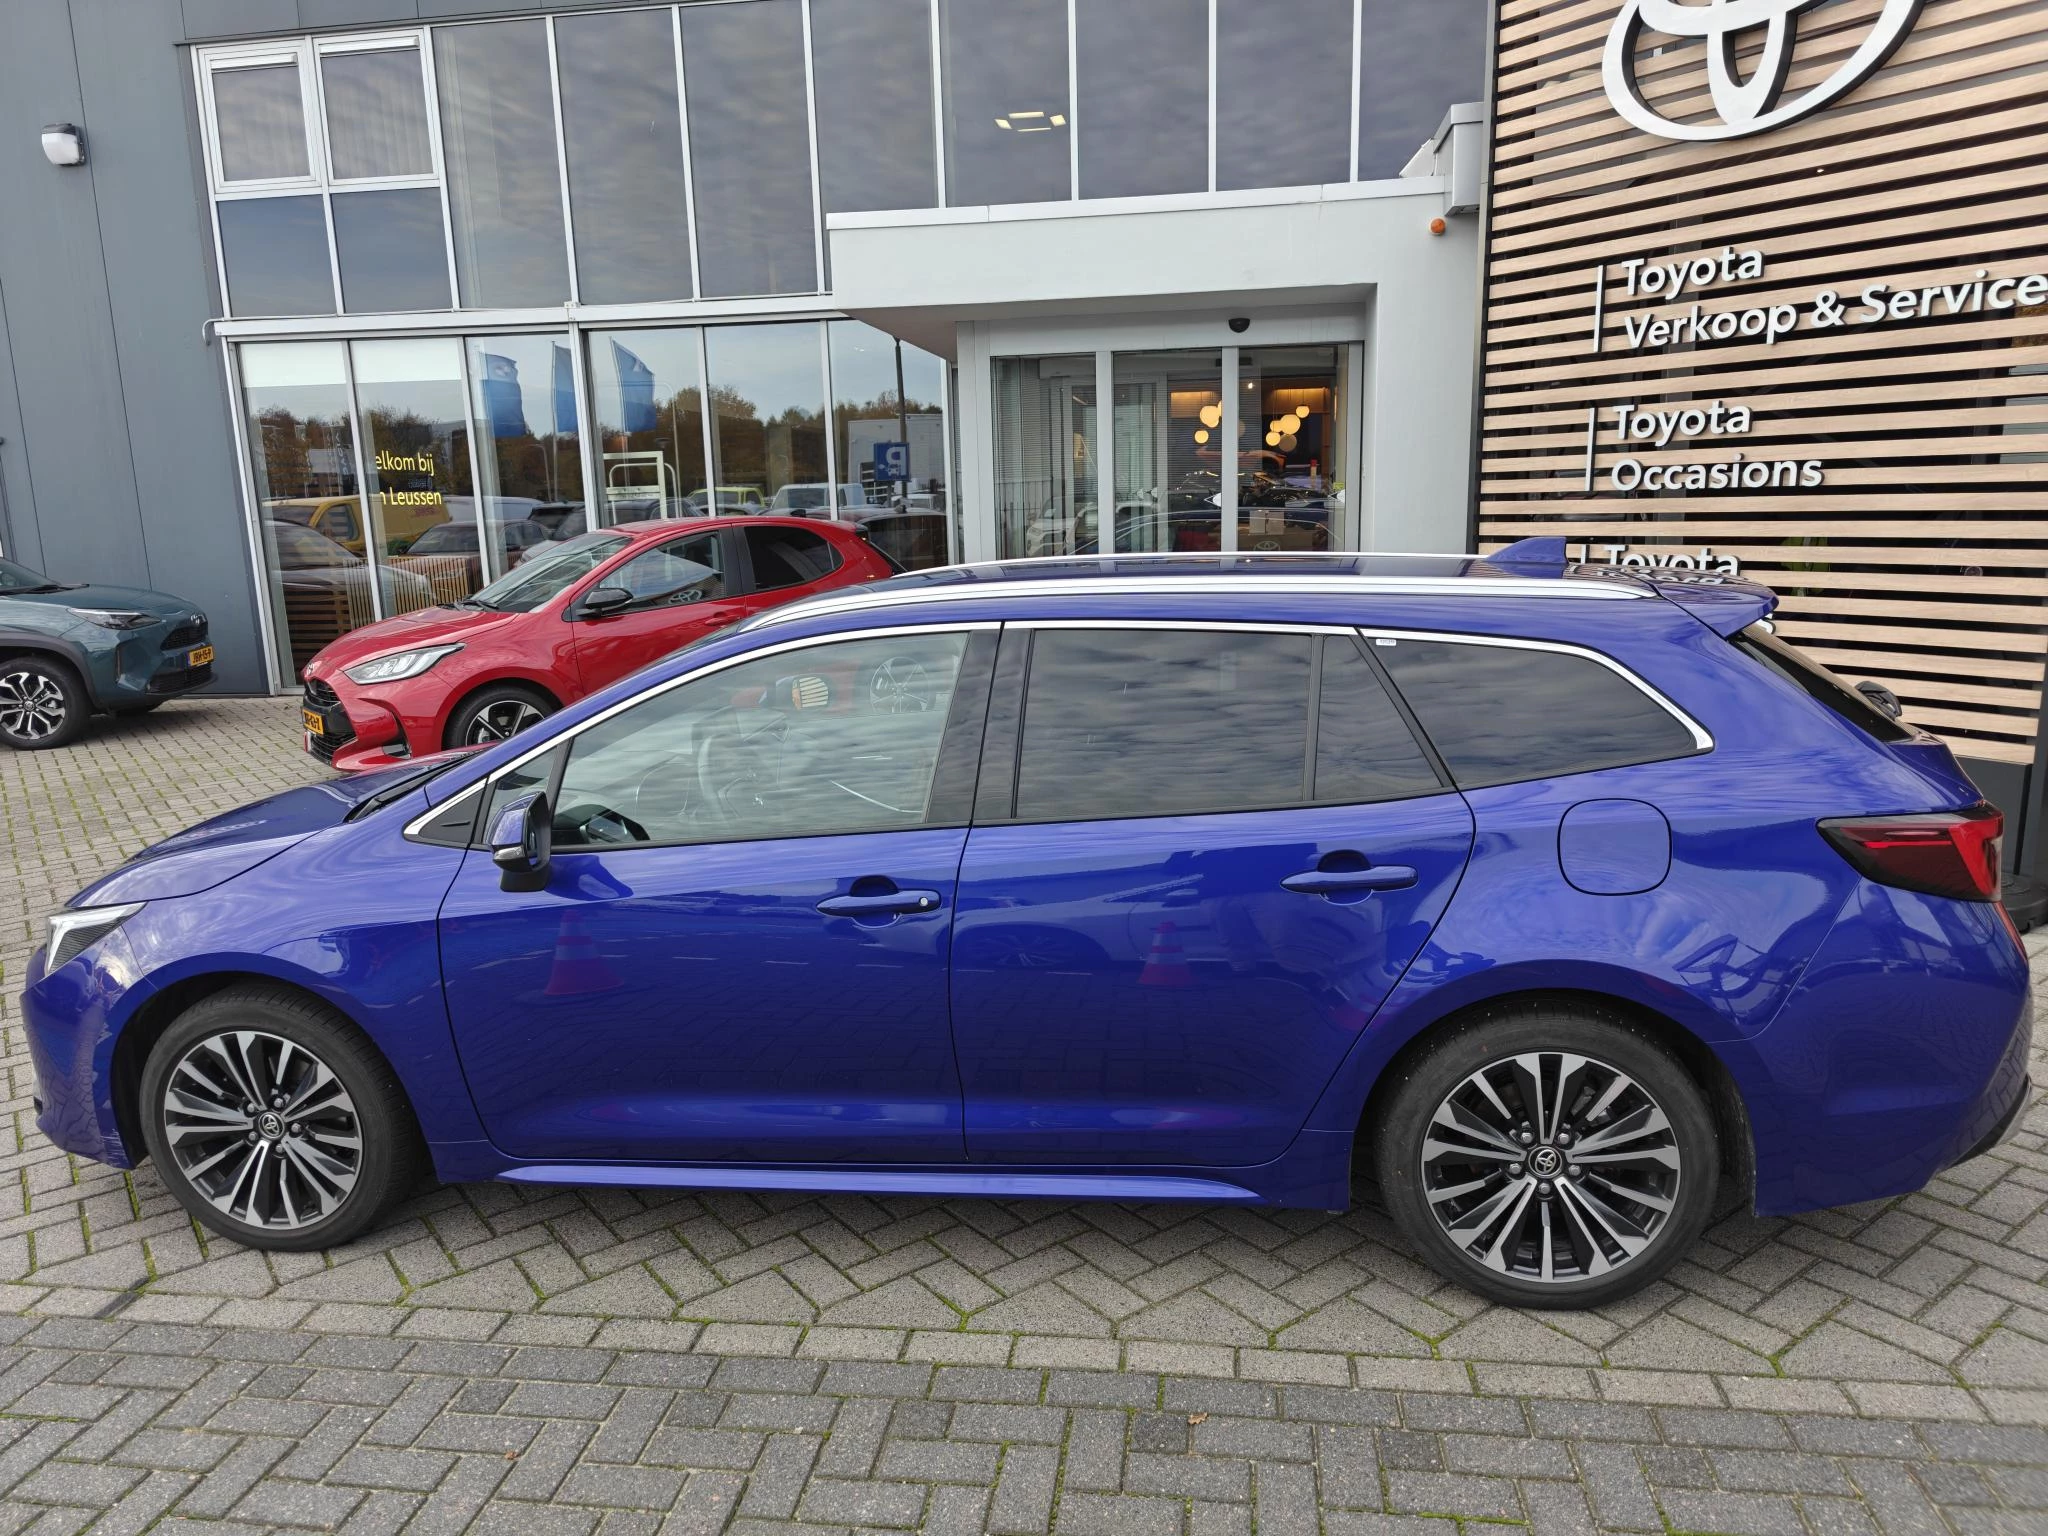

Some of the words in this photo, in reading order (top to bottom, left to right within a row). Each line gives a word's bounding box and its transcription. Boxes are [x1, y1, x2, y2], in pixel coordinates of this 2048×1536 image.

[1622, 247, 1763, 300] Toyota
[1624, 303, 1797, 345] Verkoop
[1810, 289, 1845, 327] &
[1861, 270, 2048, 323] Service
[1613, 401, 1752, 447] Toyota
[375, 450, 415, 471] elkom
[417, 452, 434, 476] bij
[1611, 453, 1825, 491] Occasions
[389, 487, 442, 506] Leussen
